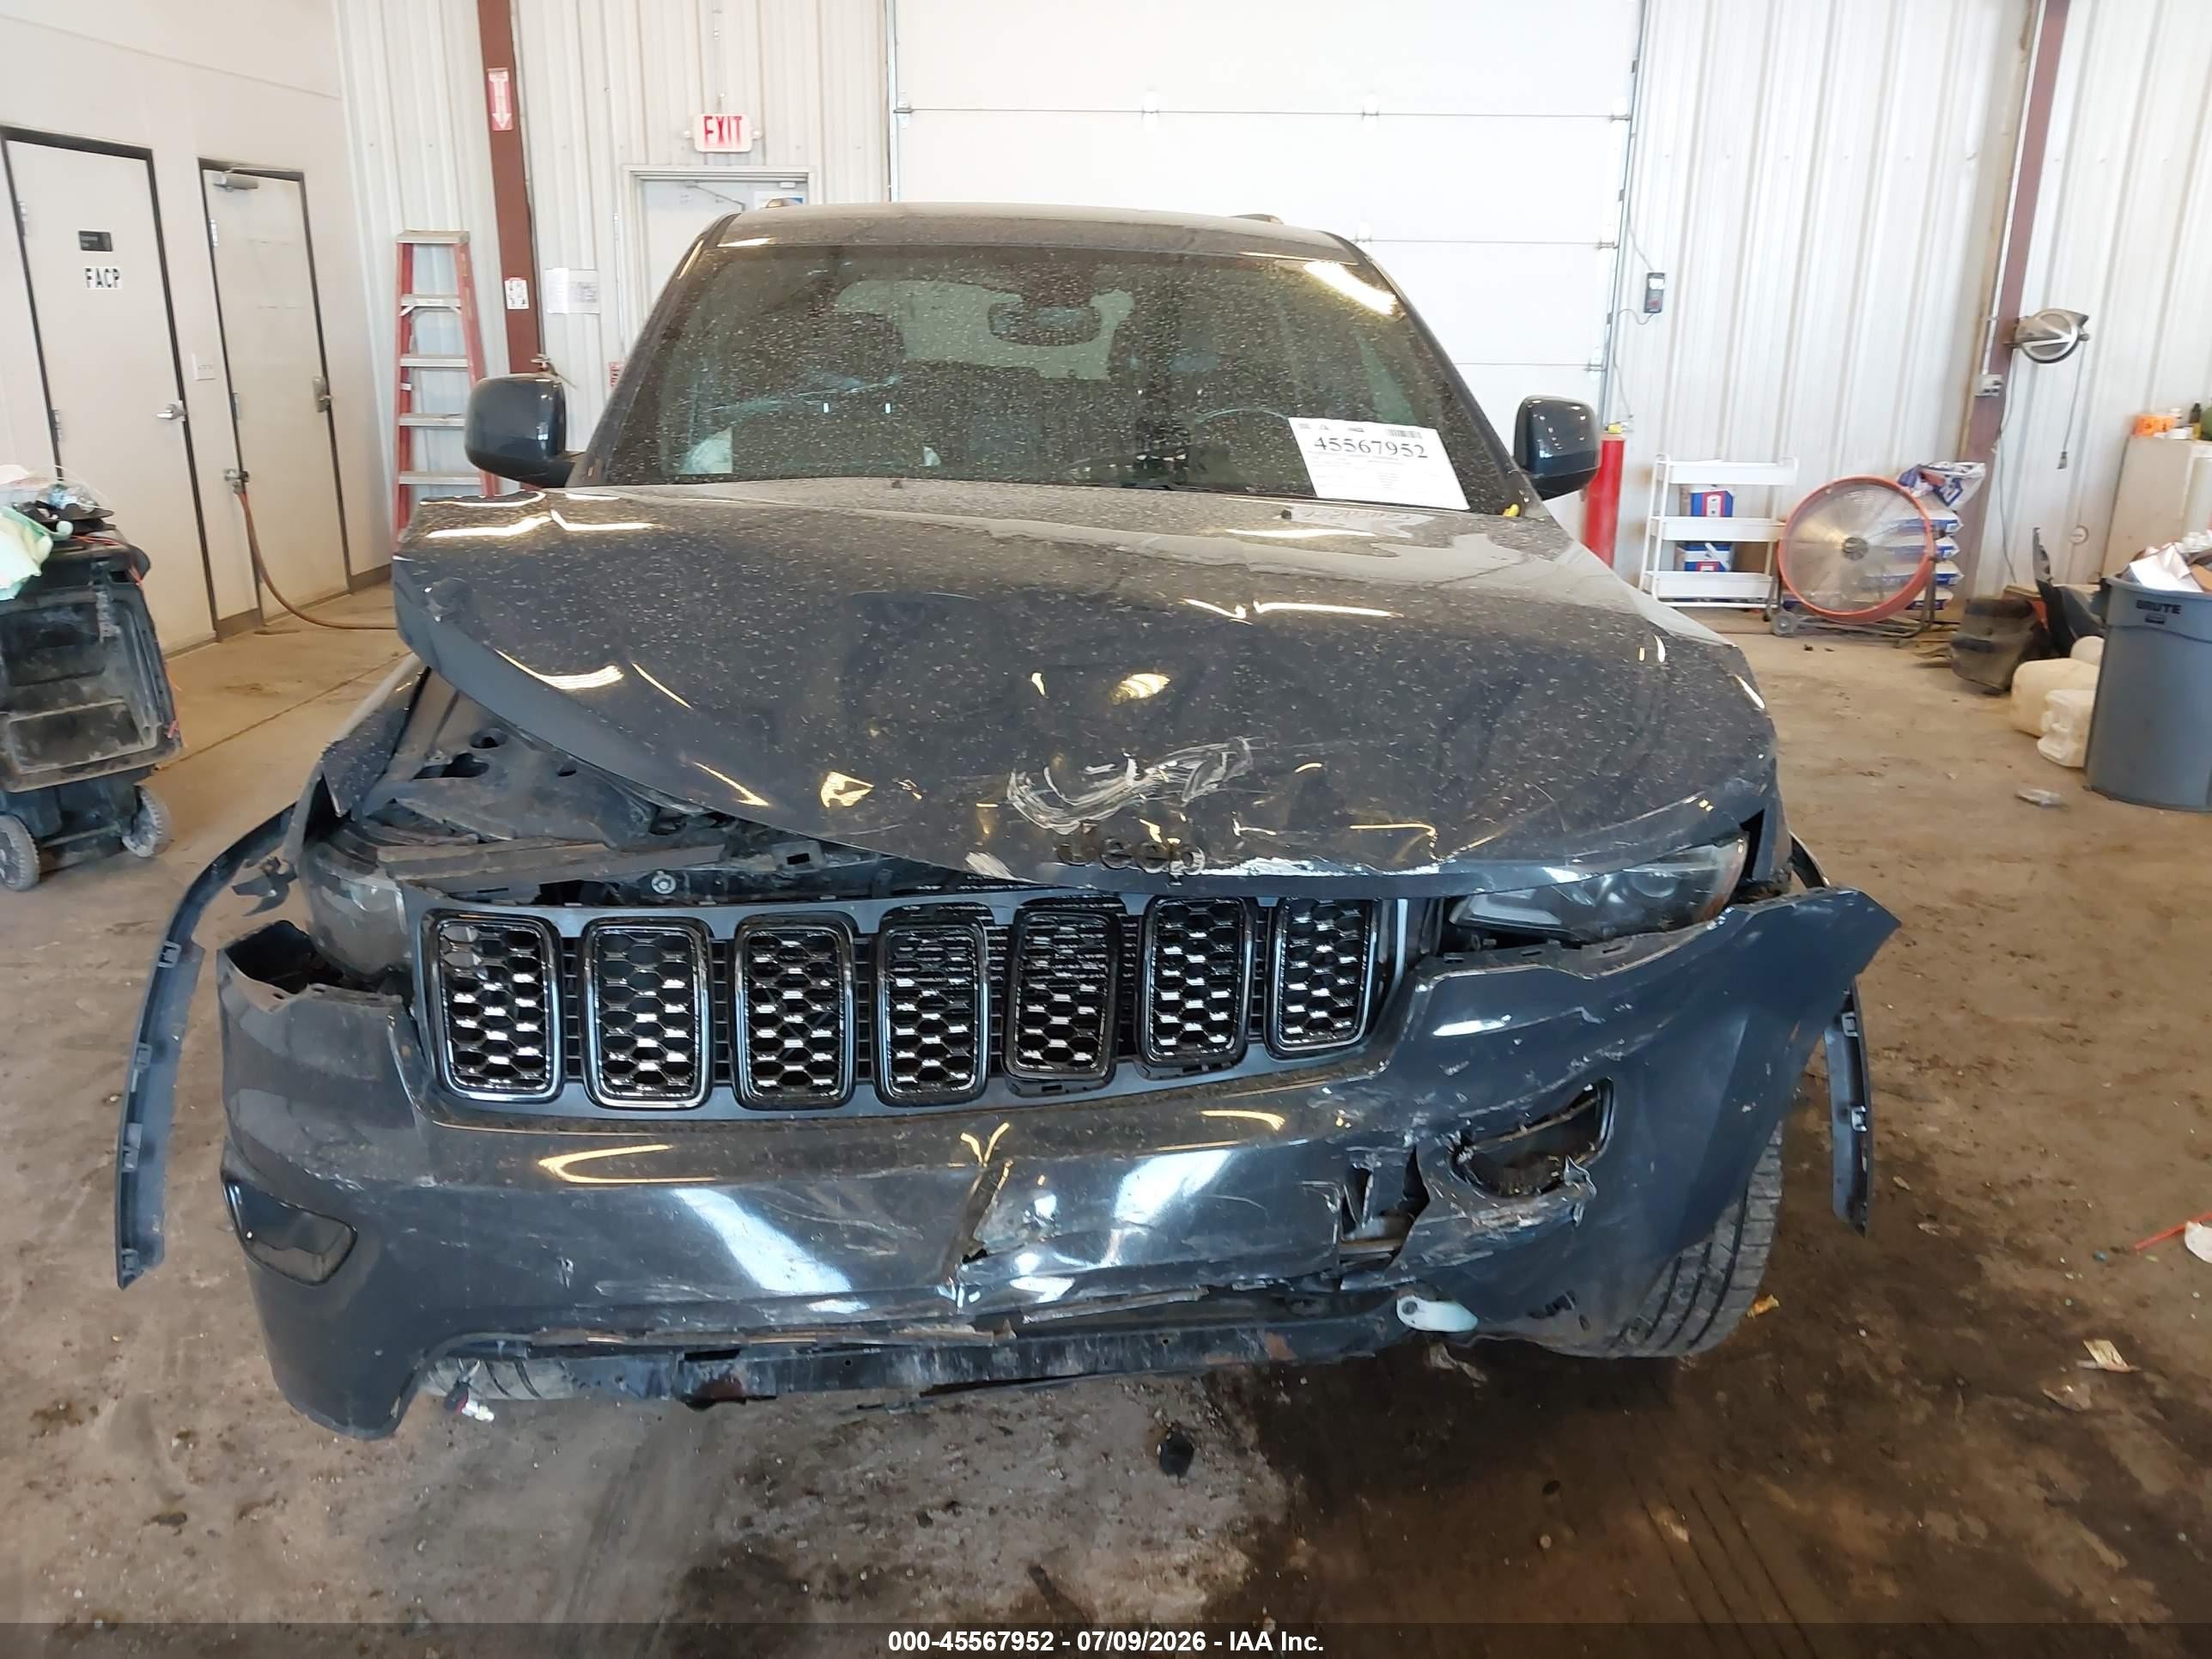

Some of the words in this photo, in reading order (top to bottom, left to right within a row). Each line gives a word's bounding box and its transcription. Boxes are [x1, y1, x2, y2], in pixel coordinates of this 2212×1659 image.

[703, 115, 743, 148] EXIT
[85, 267, 120, 289] FACP
[1314, 436, 1429, 459] 45567952
